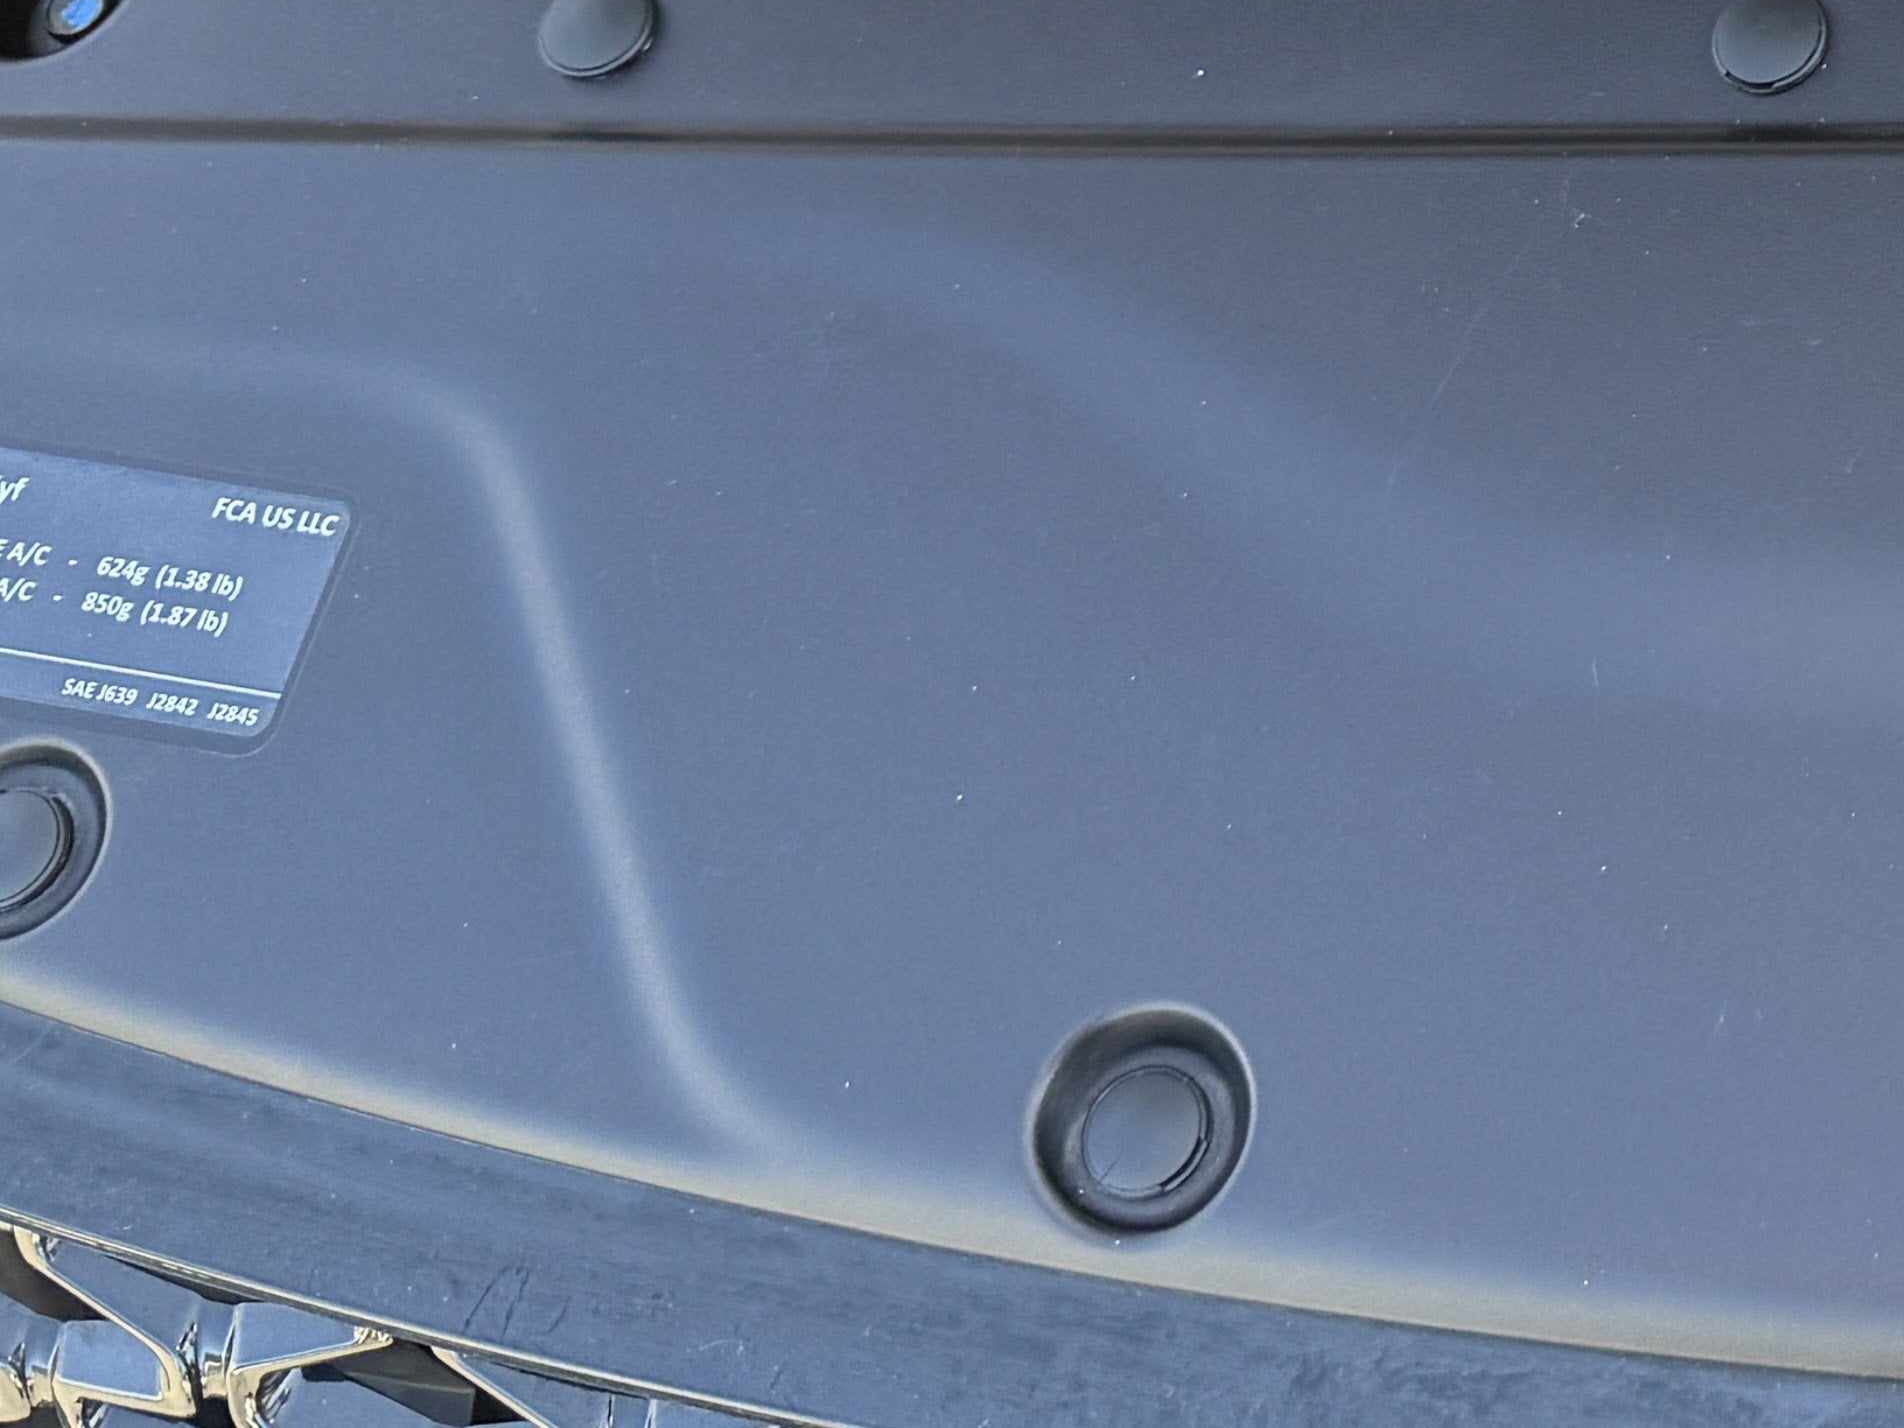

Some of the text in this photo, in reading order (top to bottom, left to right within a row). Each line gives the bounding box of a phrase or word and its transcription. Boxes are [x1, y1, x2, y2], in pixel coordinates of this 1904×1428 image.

[211, 496, 256, 525] FCA
[261, 504, 295, 530] US
[297, 510, 340, 537] LLC
[6, 541, 52, 567] A/C
[97, 555, 150, 587] 624g
[155, 564, 212, 592] (1.38
[211, 574, 244, 602] lb)
[81, 591, 134, 622] 850g
[140, 599, 196, 628] (1.87
[196, 609, 229, 638] lb)
[61, 677, 260, 726] SAE J639 J2842 J2845
